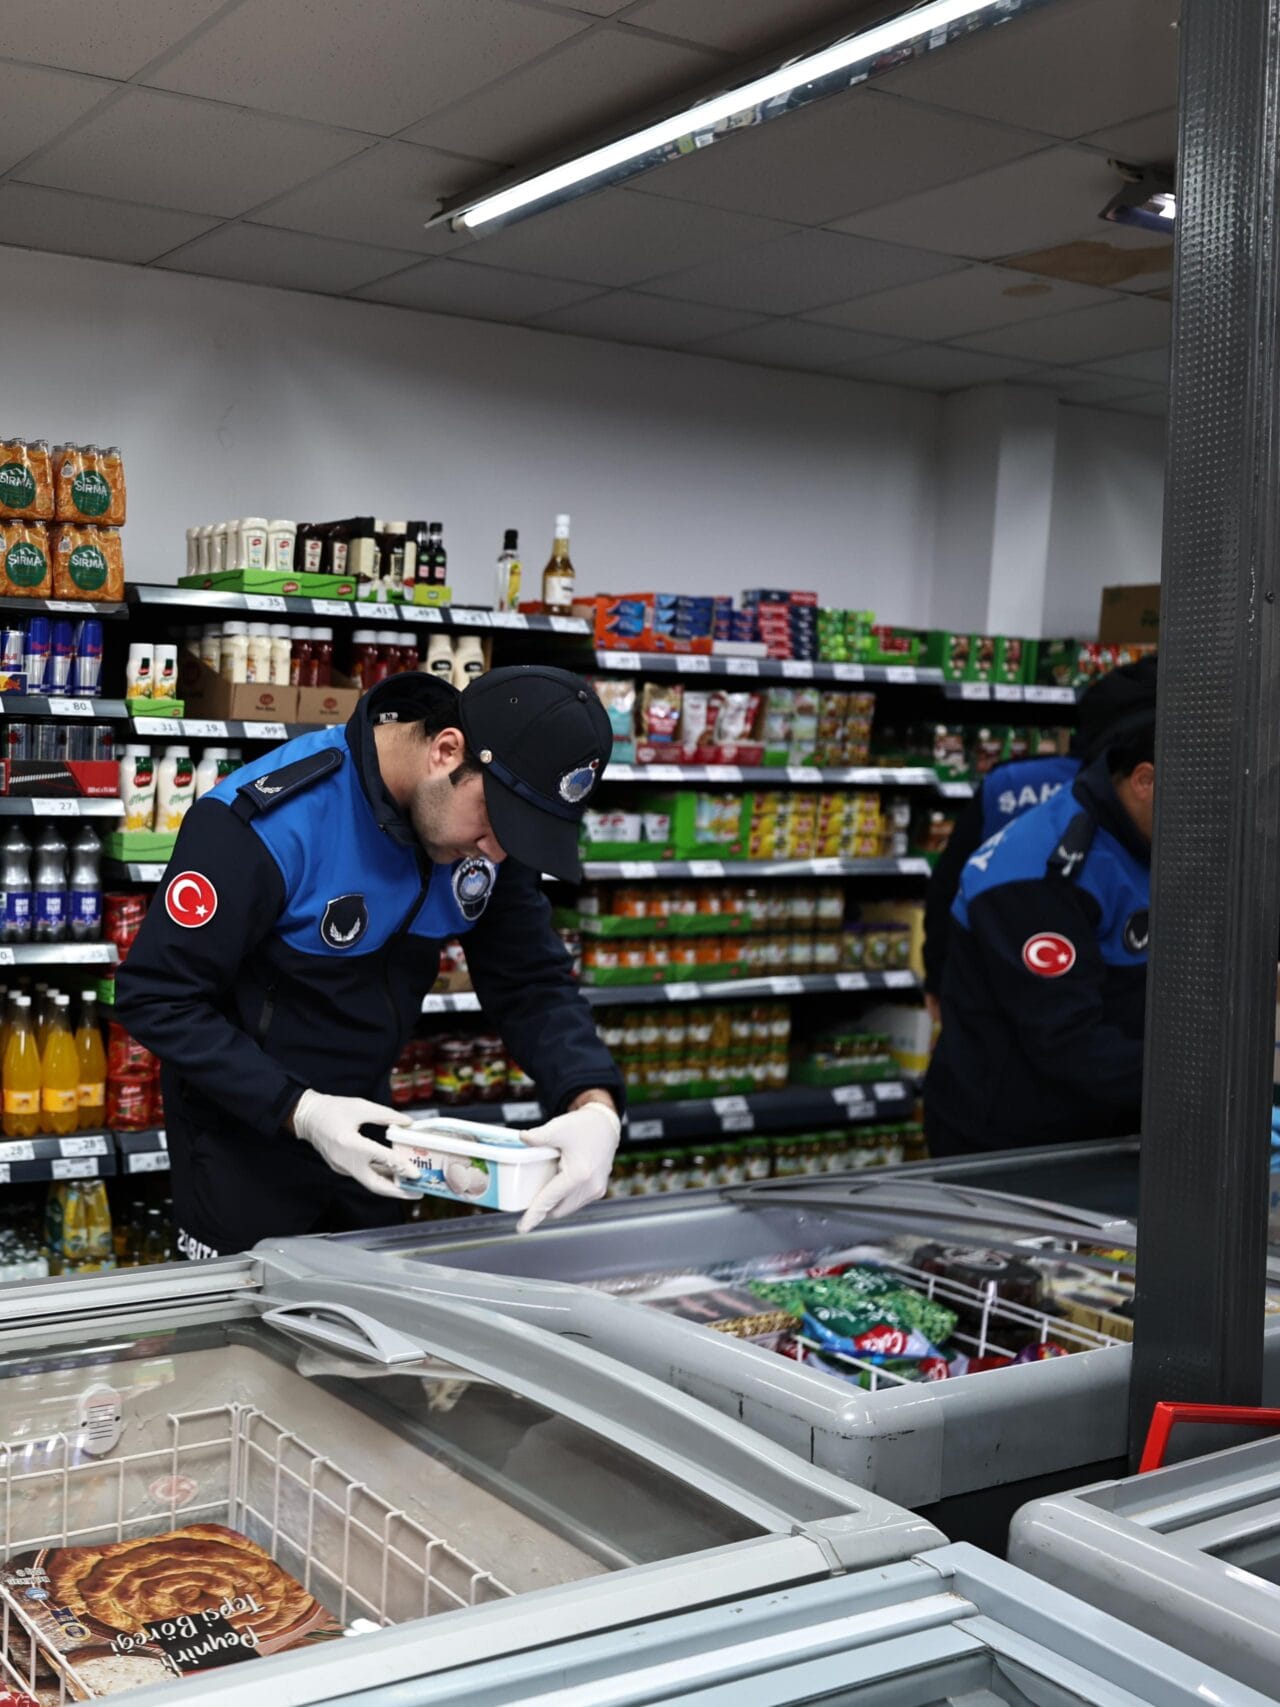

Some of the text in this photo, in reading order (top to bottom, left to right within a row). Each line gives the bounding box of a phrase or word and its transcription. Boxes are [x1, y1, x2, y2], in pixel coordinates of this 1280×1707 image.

[73, 702, 87, 711] 80
[111, 1593, 266, 1657] Tepsi Böreği
